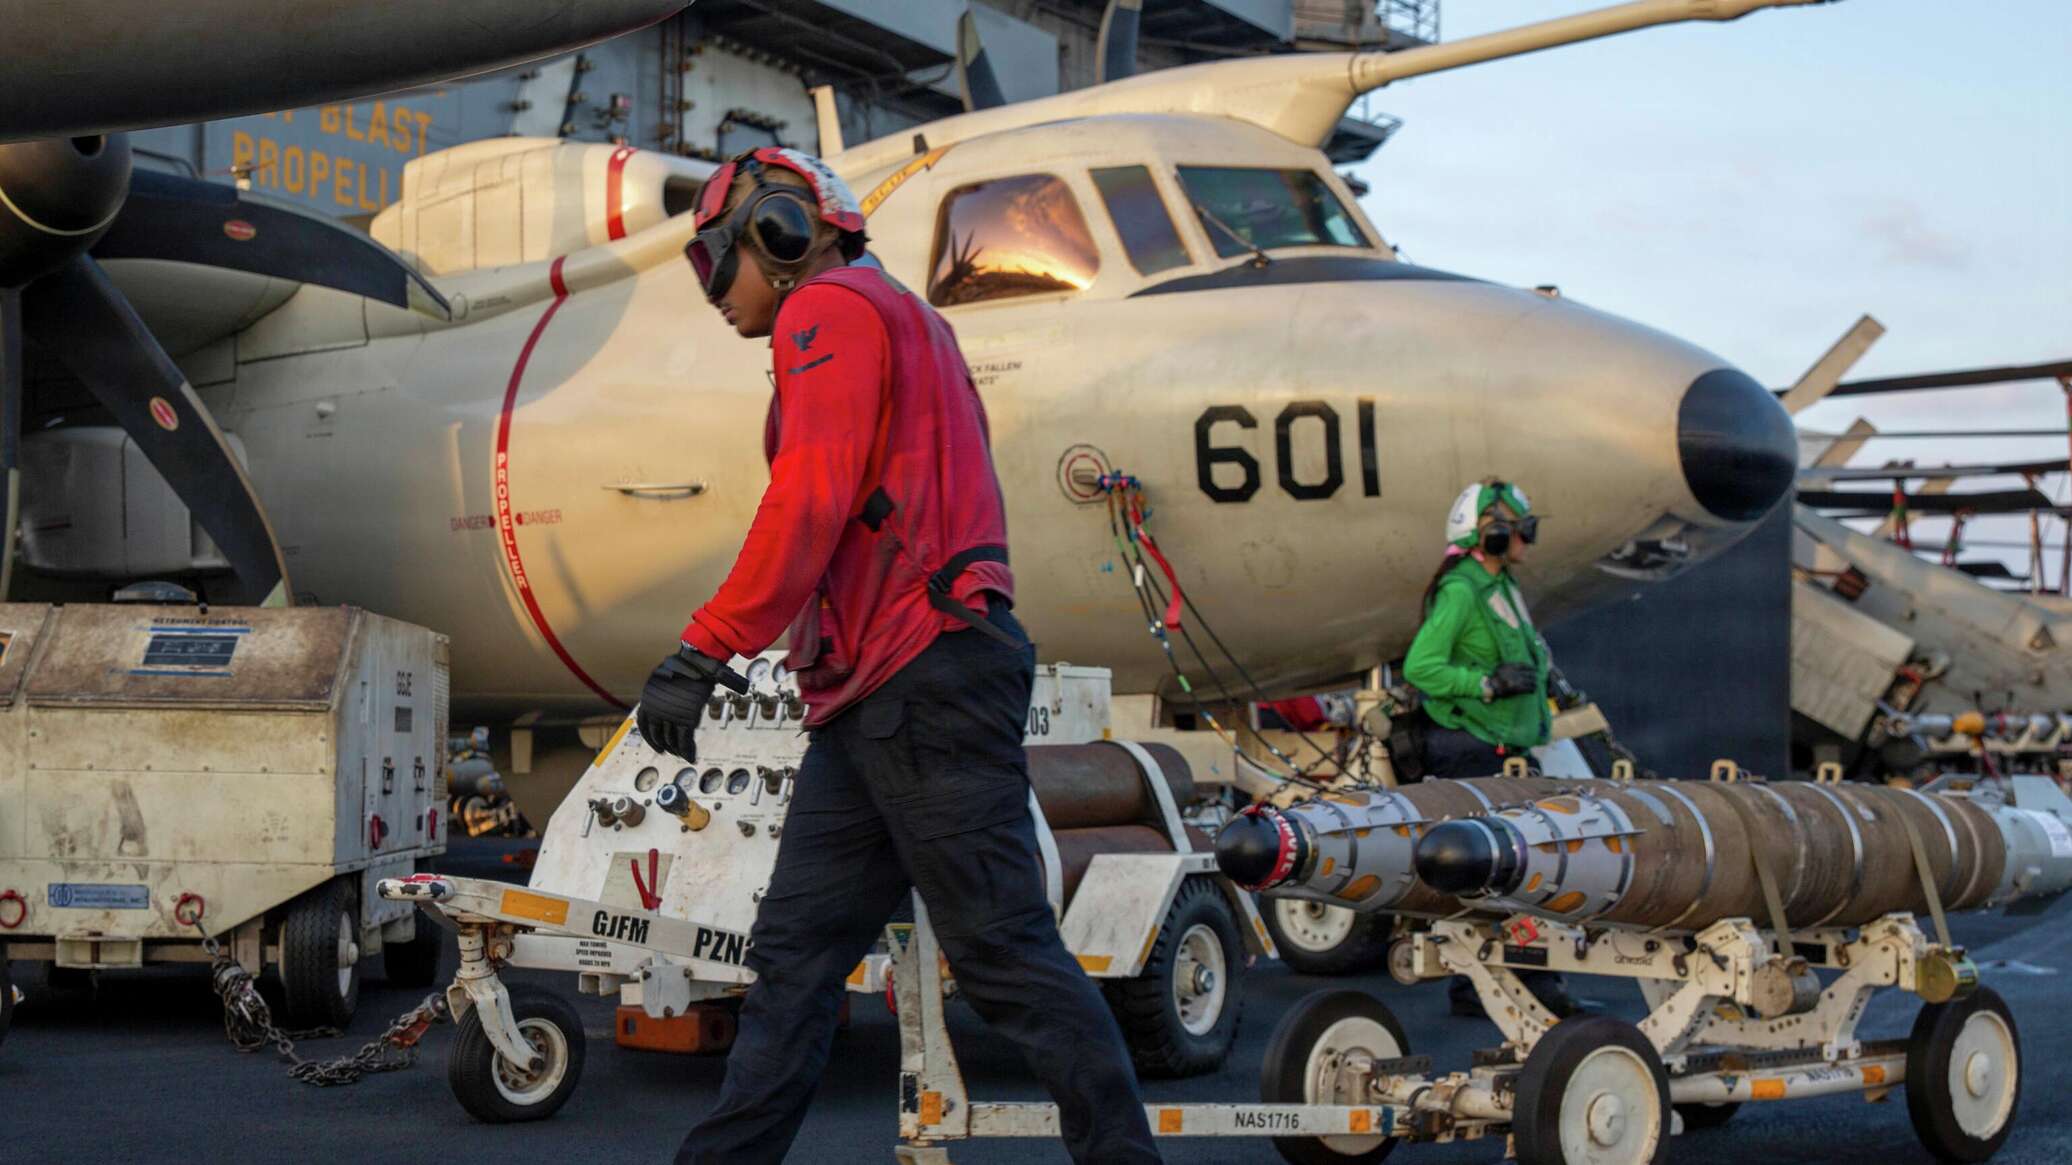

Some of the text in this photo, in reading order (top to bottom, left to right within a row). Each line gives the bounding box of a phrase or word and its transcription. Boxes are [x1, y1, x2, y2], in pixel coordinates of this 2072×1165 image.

[321, 100, 432, 156] BLAST
[234, 131, 404, 211] PROPELL
[1194, 395, 1380, 503] 601
[450, 514, 489, 531] DANGER
[496, 451, 529, 590] PROPELLER
[523, 508, 562, 525] DANGER
[1024, 706, 1049, 735] 03
[592, 909, 650, 945] GJFM
[1235, 1110, 1300, 1130] NAS1716
